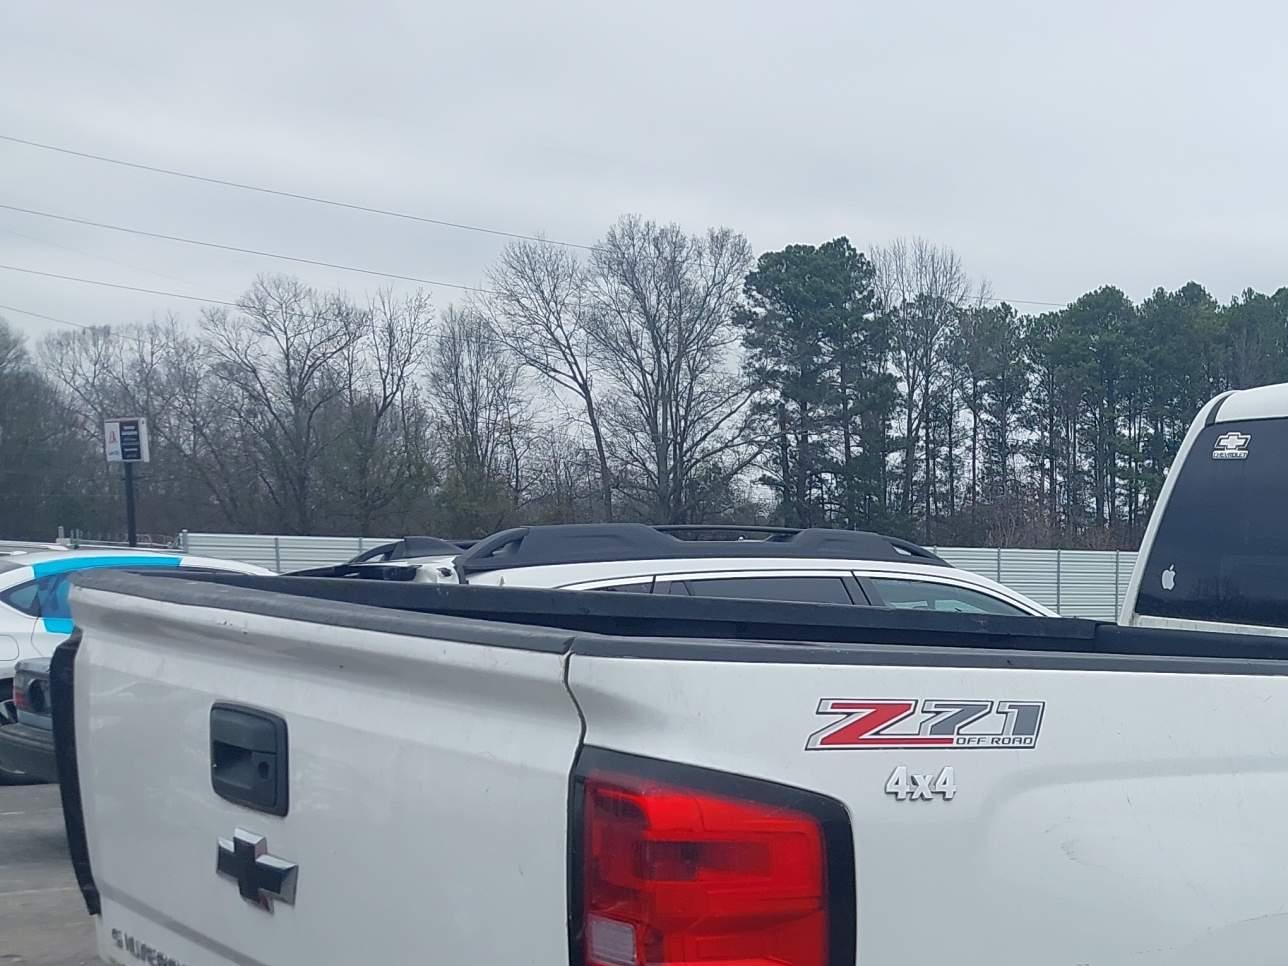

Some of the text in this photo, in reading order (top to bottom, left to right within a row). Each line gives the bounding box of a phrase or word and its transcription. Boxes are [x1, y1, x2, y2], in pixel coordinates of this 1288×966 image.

[805, 698, 1045, 751] Z71
[956, 737, 1033, 745] OFF ROAD
[885, 766, 957, 801] 4x4
